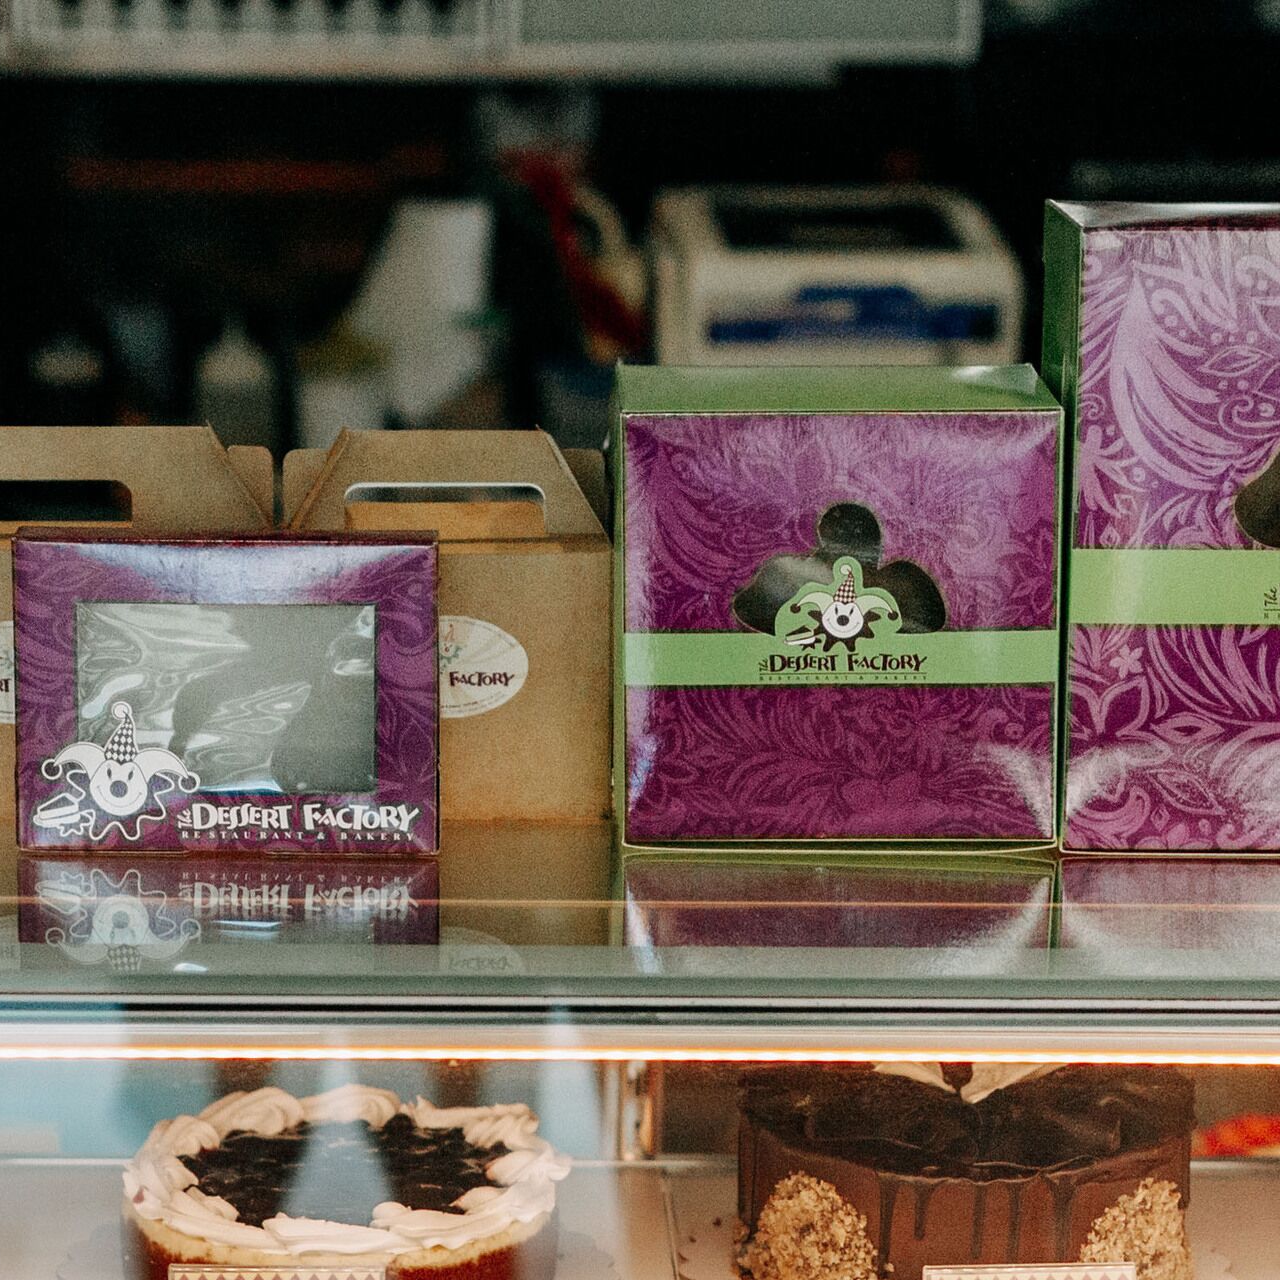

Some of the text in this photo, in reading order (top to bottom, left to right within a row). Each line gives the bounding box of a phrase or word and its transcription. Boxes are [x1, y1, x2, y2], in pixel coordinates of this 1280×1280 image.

[769, 653, 839, 673] DESSERT
[846, 652, 928, 672] FACTORY
[449, 670, 516, 688] FACTORY
[192, 803, 293, 830] DESSERT
[302, 803, 420, 832] FACTORY
[181, 831, 305, 840] RESTAURANT
[340, 831, 416, 841] BAKERY
